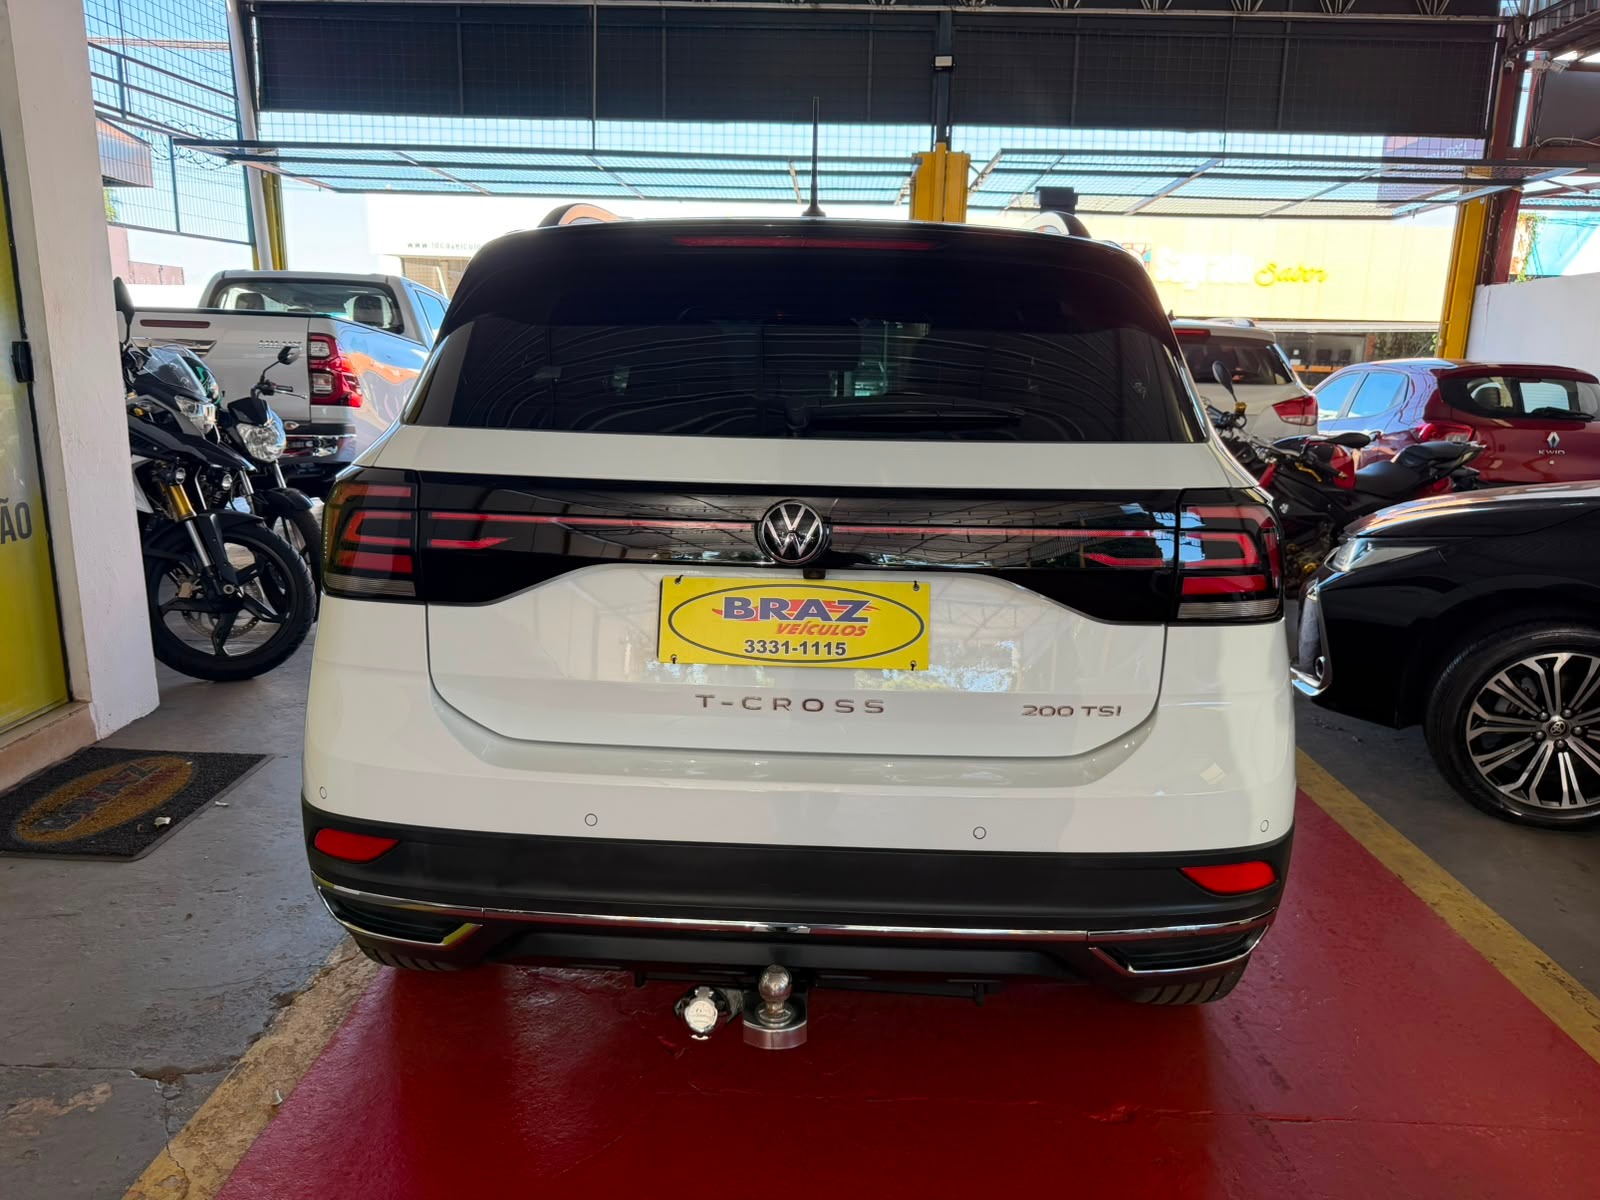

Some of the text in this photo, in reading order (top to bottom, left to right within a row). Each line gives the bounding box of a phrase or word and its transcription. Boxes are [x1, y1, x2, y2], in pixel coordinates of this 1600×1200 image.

[722, 596, 871, 623] BRAZ
[775, 620, 870, 637] VEÍCULOS
[743, 639, 847, 657] 3331-1115
[695, 694, 885, 714] T-CROSS
[1021, 704, 1122, 718] 200 TSI
